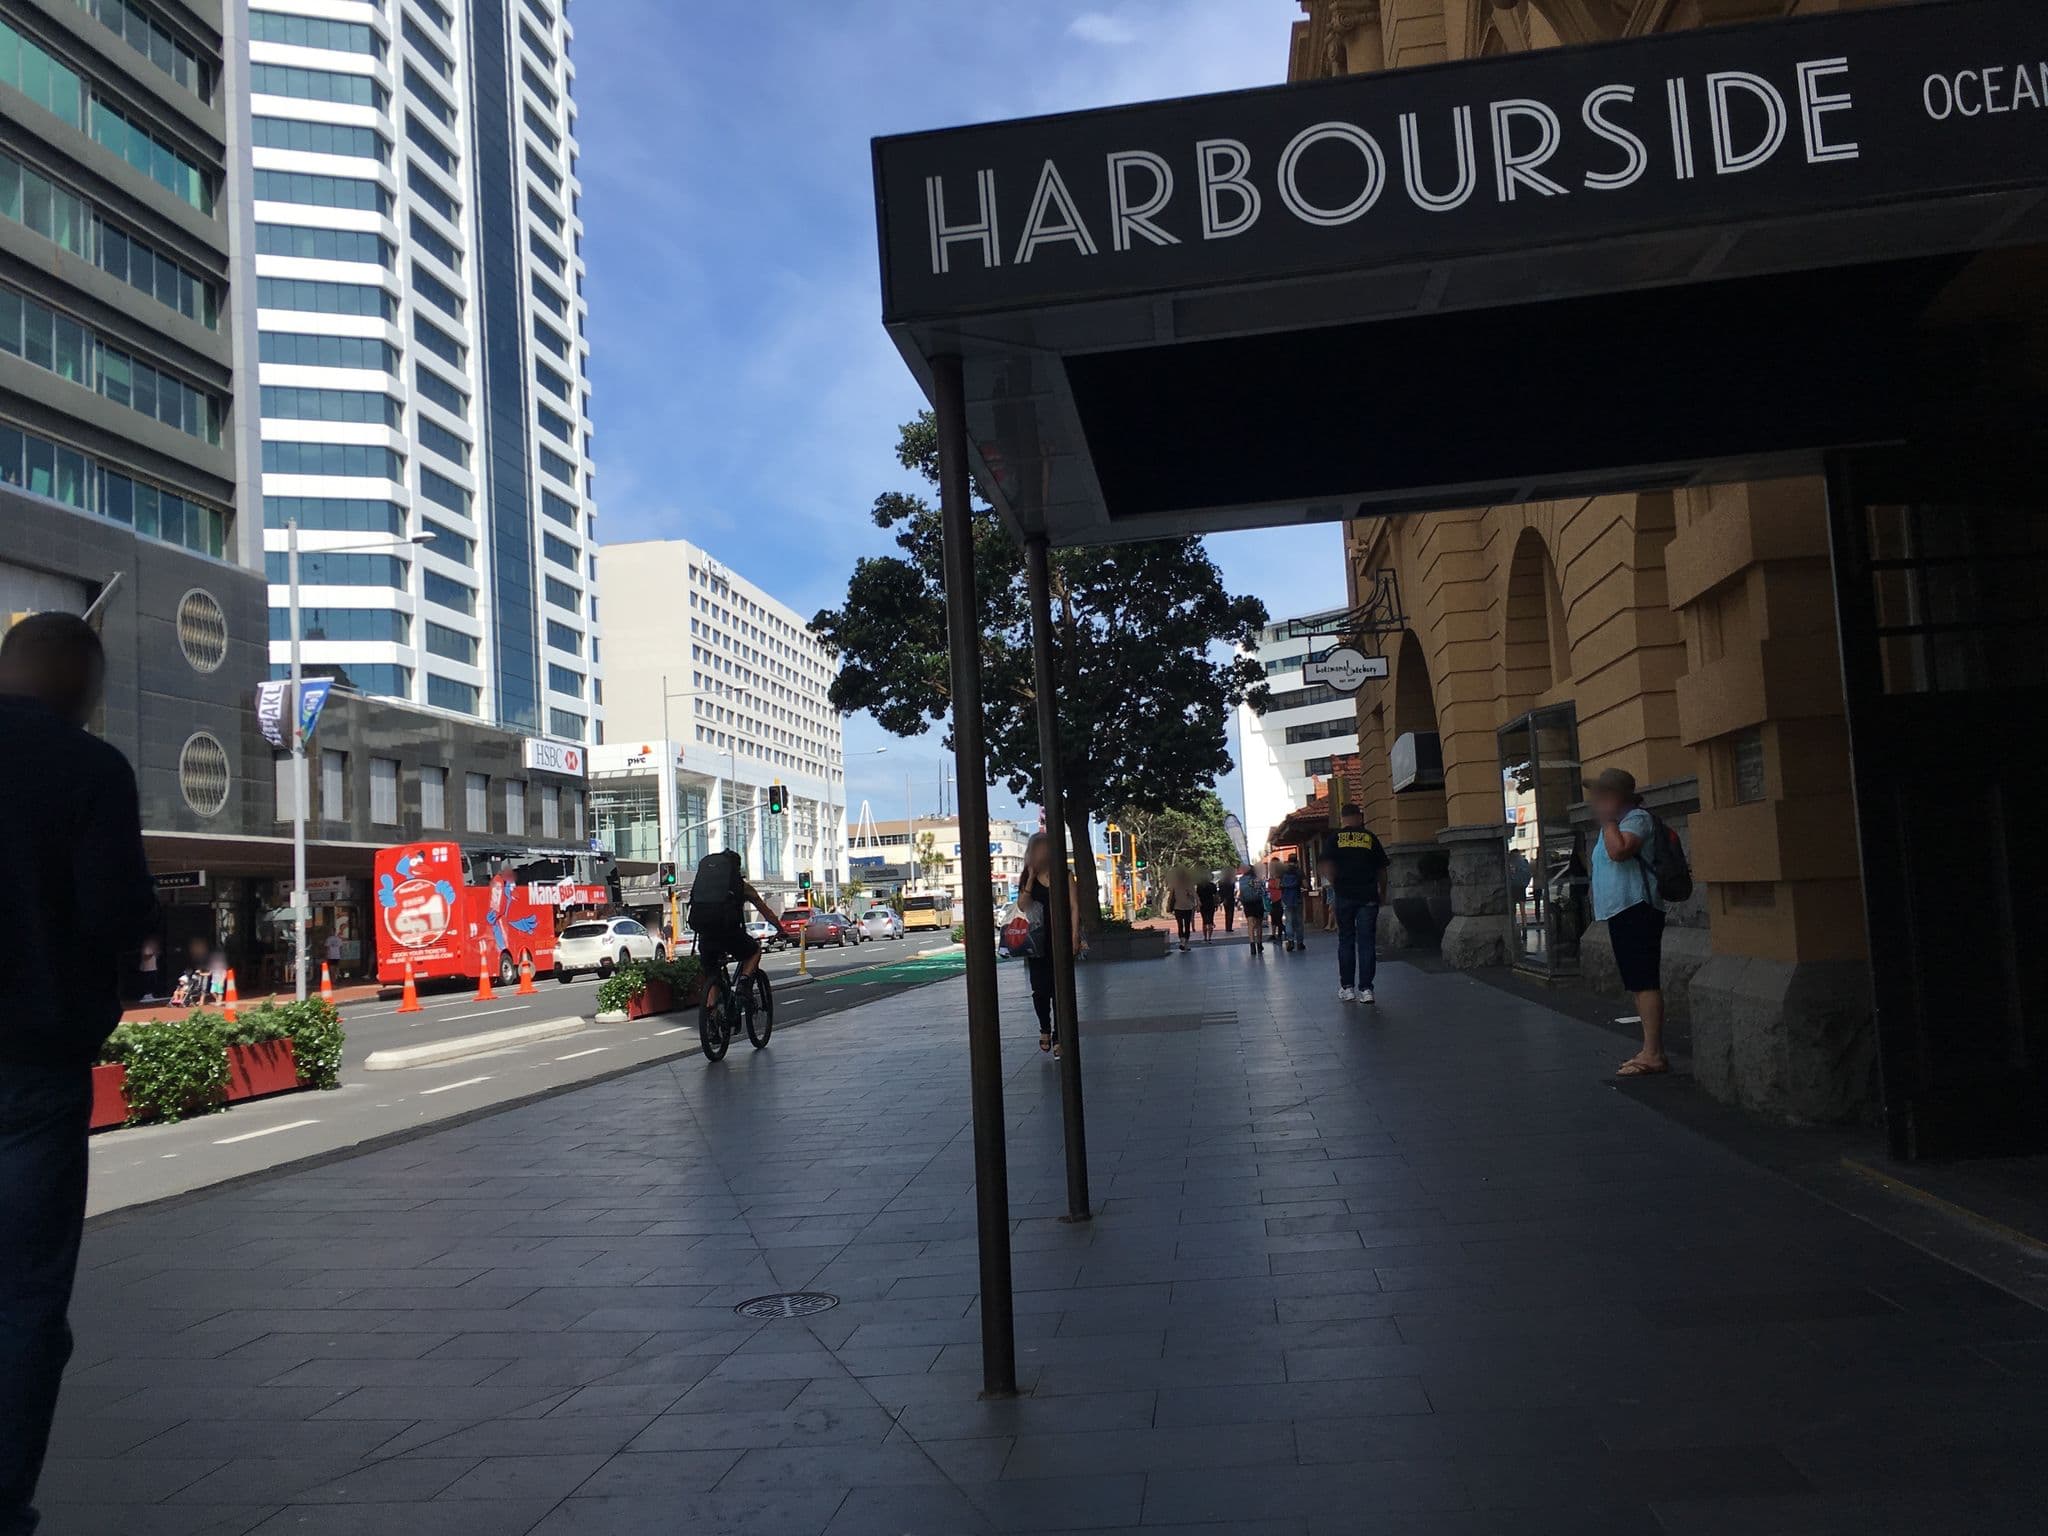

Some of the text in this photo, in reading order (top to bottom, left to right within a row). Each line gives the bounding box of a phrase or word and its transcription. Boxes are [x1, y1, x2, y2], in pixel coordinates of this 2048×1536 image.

[926, 57, 1859, 274] HARBOURSIDE
[536, 743, 562, 768] HSBC
[627, 757, 647, 767] pwc
